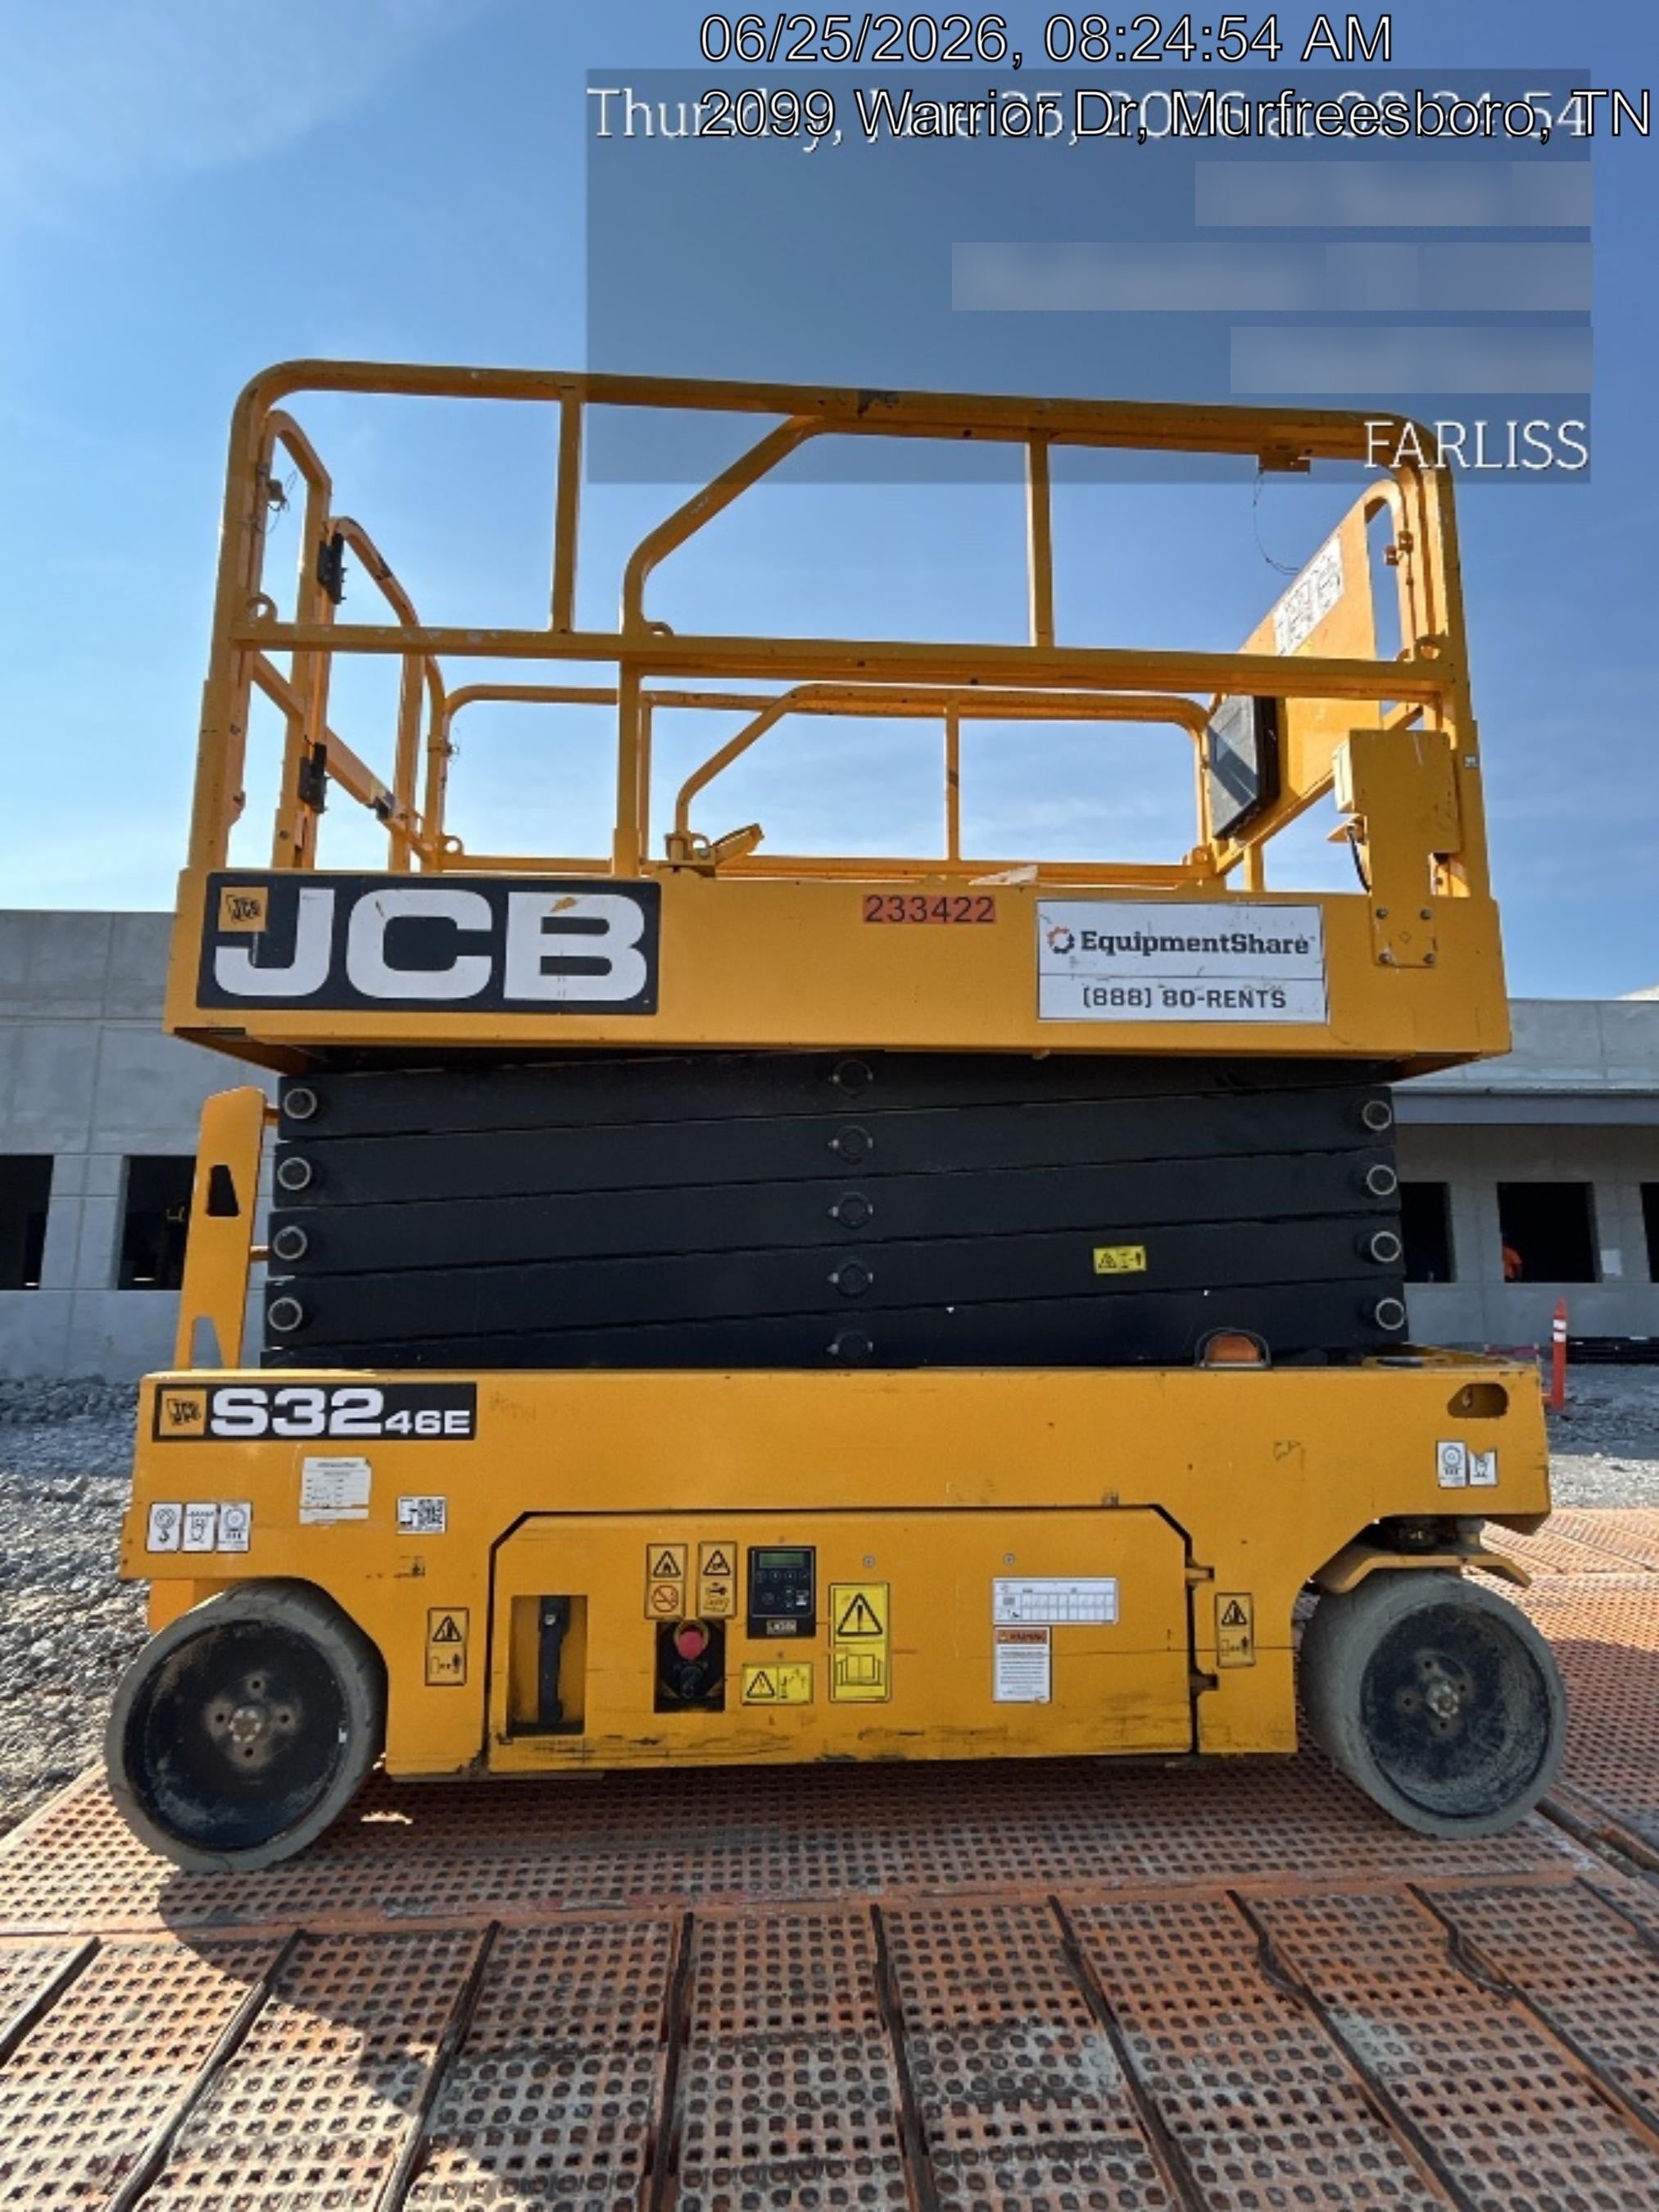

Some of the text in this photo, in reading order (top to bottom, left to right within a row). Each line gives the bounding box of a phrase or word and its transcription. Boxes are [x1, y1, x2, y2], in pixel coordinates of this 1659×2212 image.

[866, 895, 995, 922] 233422
[214, 887, 647, 1001] JCB
[1081, 931, 1309, 957] EquipmentShare
[1162, 989, 1287, 1009] 80-RENTS
